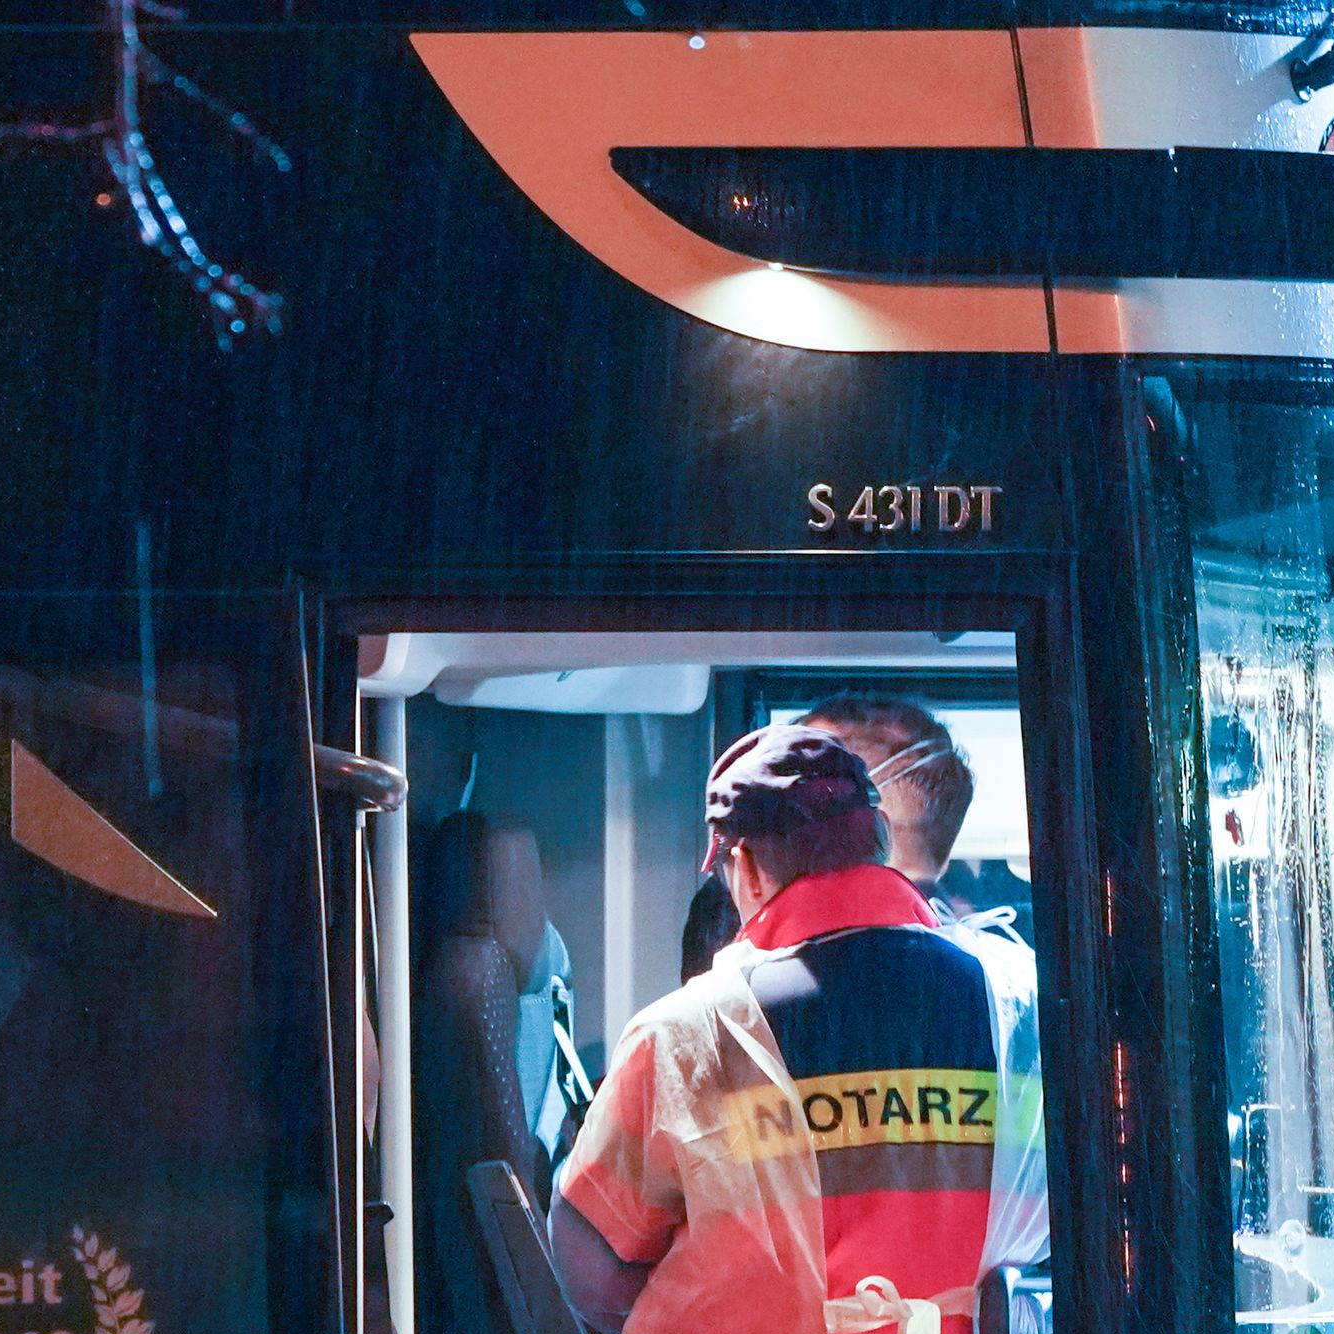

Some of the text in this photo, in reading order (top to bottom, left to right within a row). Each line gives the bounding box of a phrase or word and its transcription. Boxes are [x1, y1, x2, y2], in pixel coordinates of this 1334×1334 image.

[807, 483, 1004, 532] S 431 DT
[753, 1086, 997, 1141] NOTARZ
